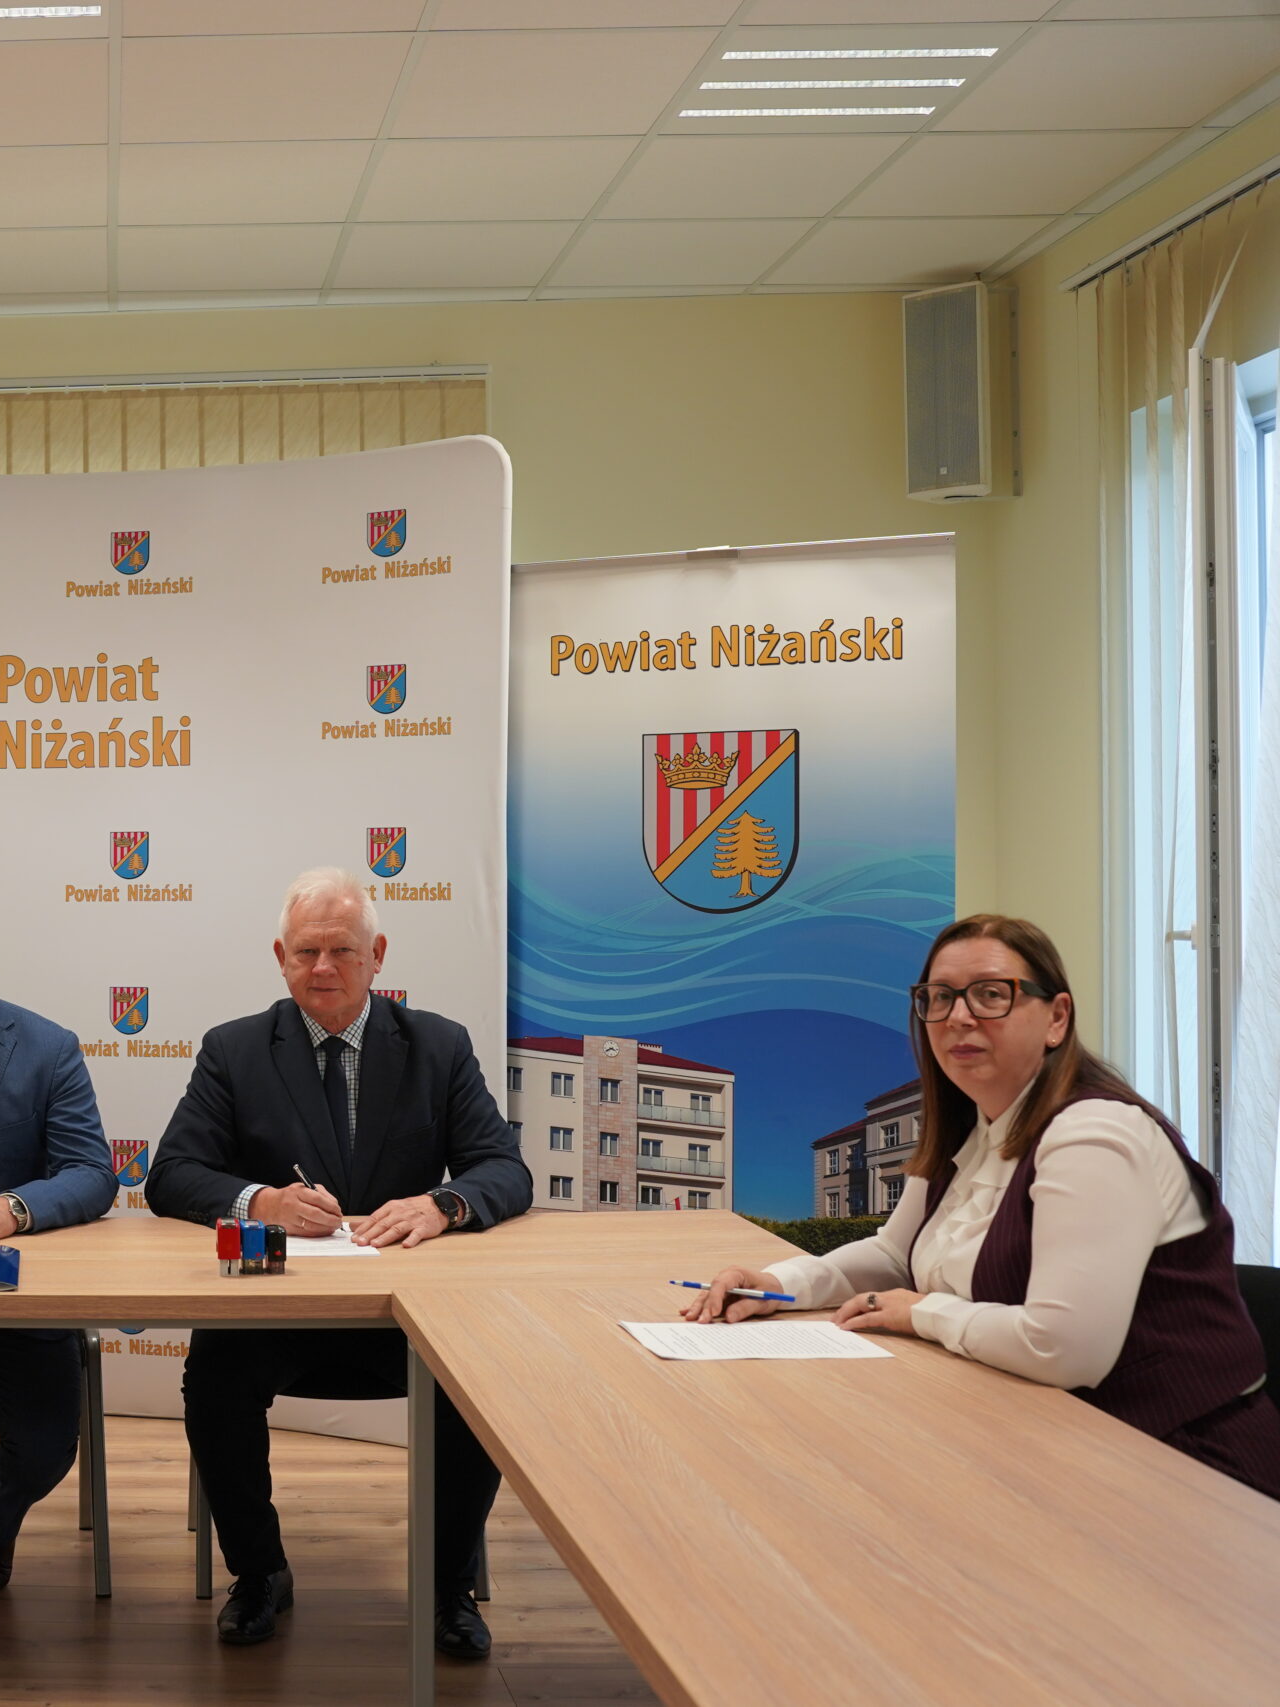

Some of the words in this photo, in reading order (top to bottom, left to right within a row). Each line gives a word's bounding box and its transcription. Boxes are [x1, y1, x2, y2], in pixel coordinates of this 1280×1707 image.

[322, 565, 377, 584] Powiat
[384, 556, 452, 579] Niżański
[65, 579, 120, 598] Powiat
[127, 576, 193, 596] Niżański
[550, 630, 697, 677] Powiat
[710, 616, 904, 668] Niżański
[321, 720, 377, 740] Powiat
[384, 716, 452, 737] Niżański
[65, 884, 120, 903] Powiat
[127, 883, 193, 902] Niżański
[384, 882, 452, 901] Niżański
[80, 1039, 120, 1057] wiat
[127, 1039, 193, 1058] Niżański
[129, 1338, 190, 1358] Niżańsk
